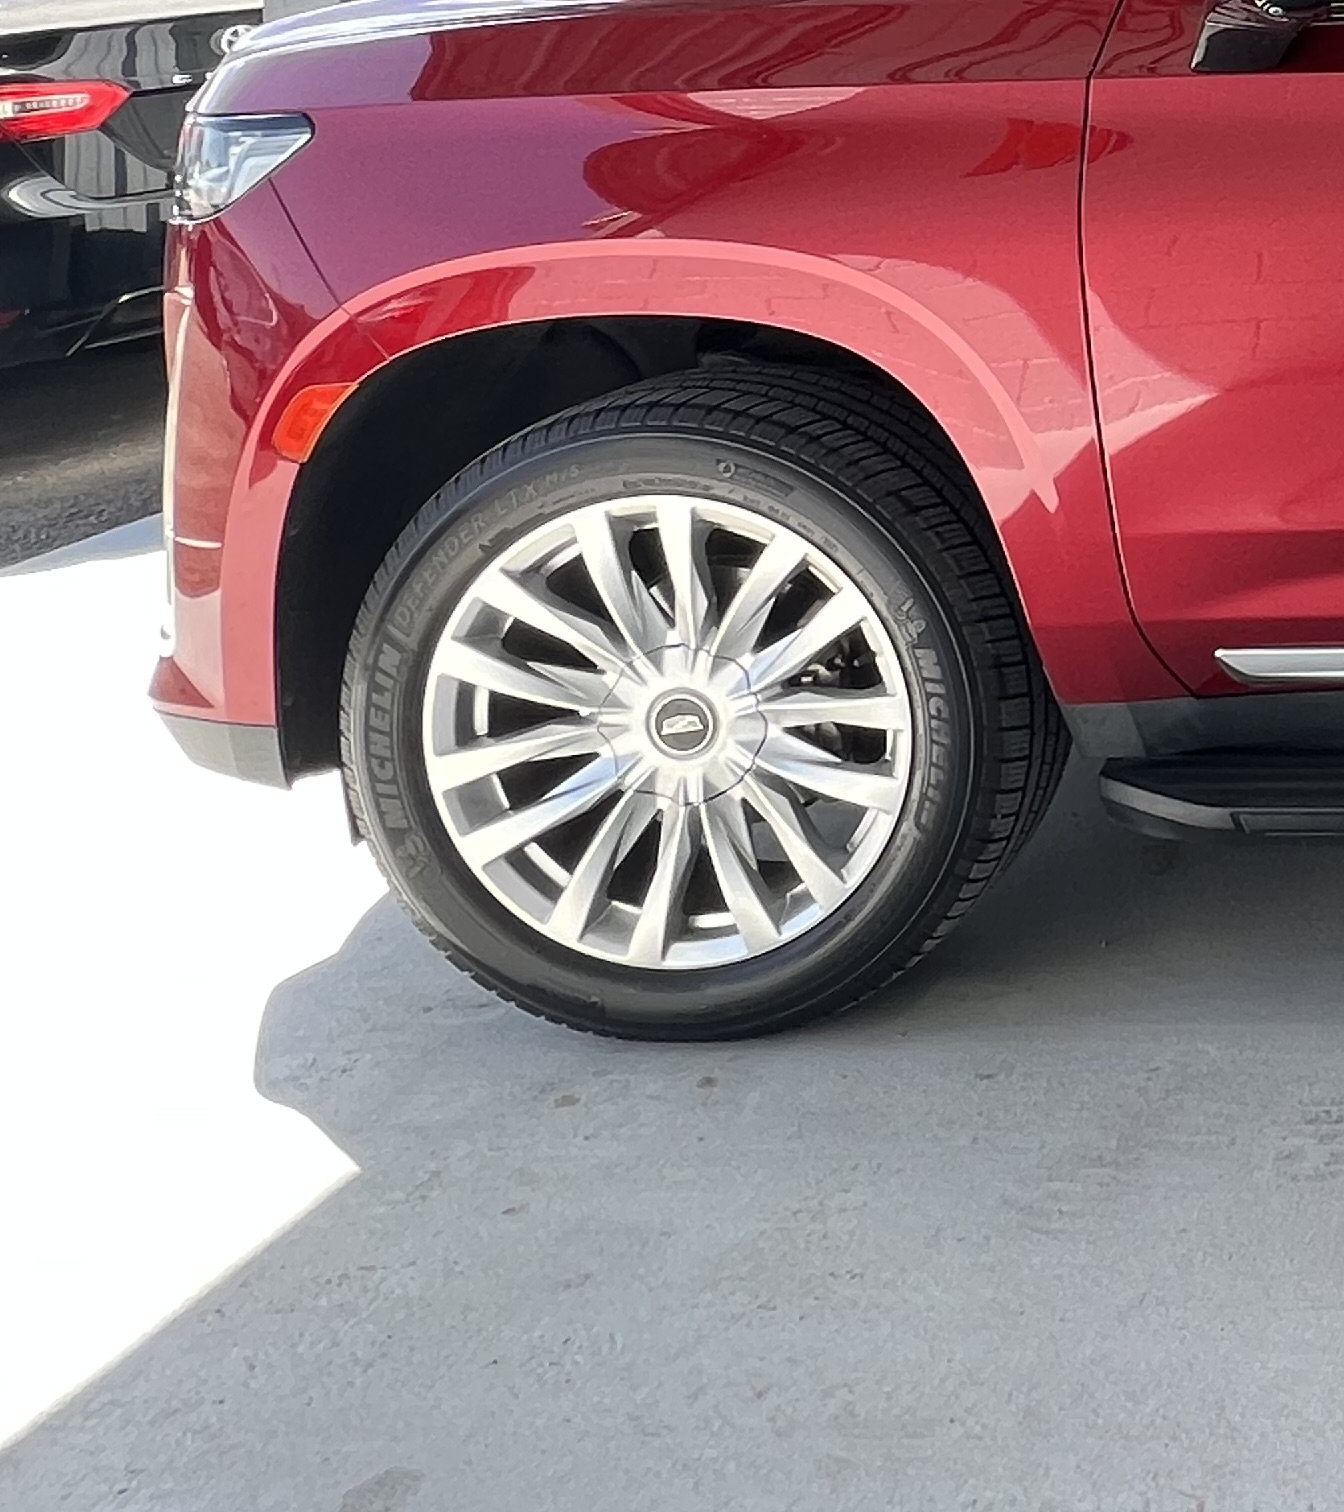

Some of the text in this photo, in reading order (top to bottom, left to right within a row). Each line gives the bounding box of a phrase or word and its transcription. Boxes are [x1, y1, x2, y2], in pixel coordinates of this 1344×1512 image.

[366, 644, 400, 831] MICHELIN
[398, 514, 489, 628] DEFENDER
[493, 485, 541, 522] LTX
